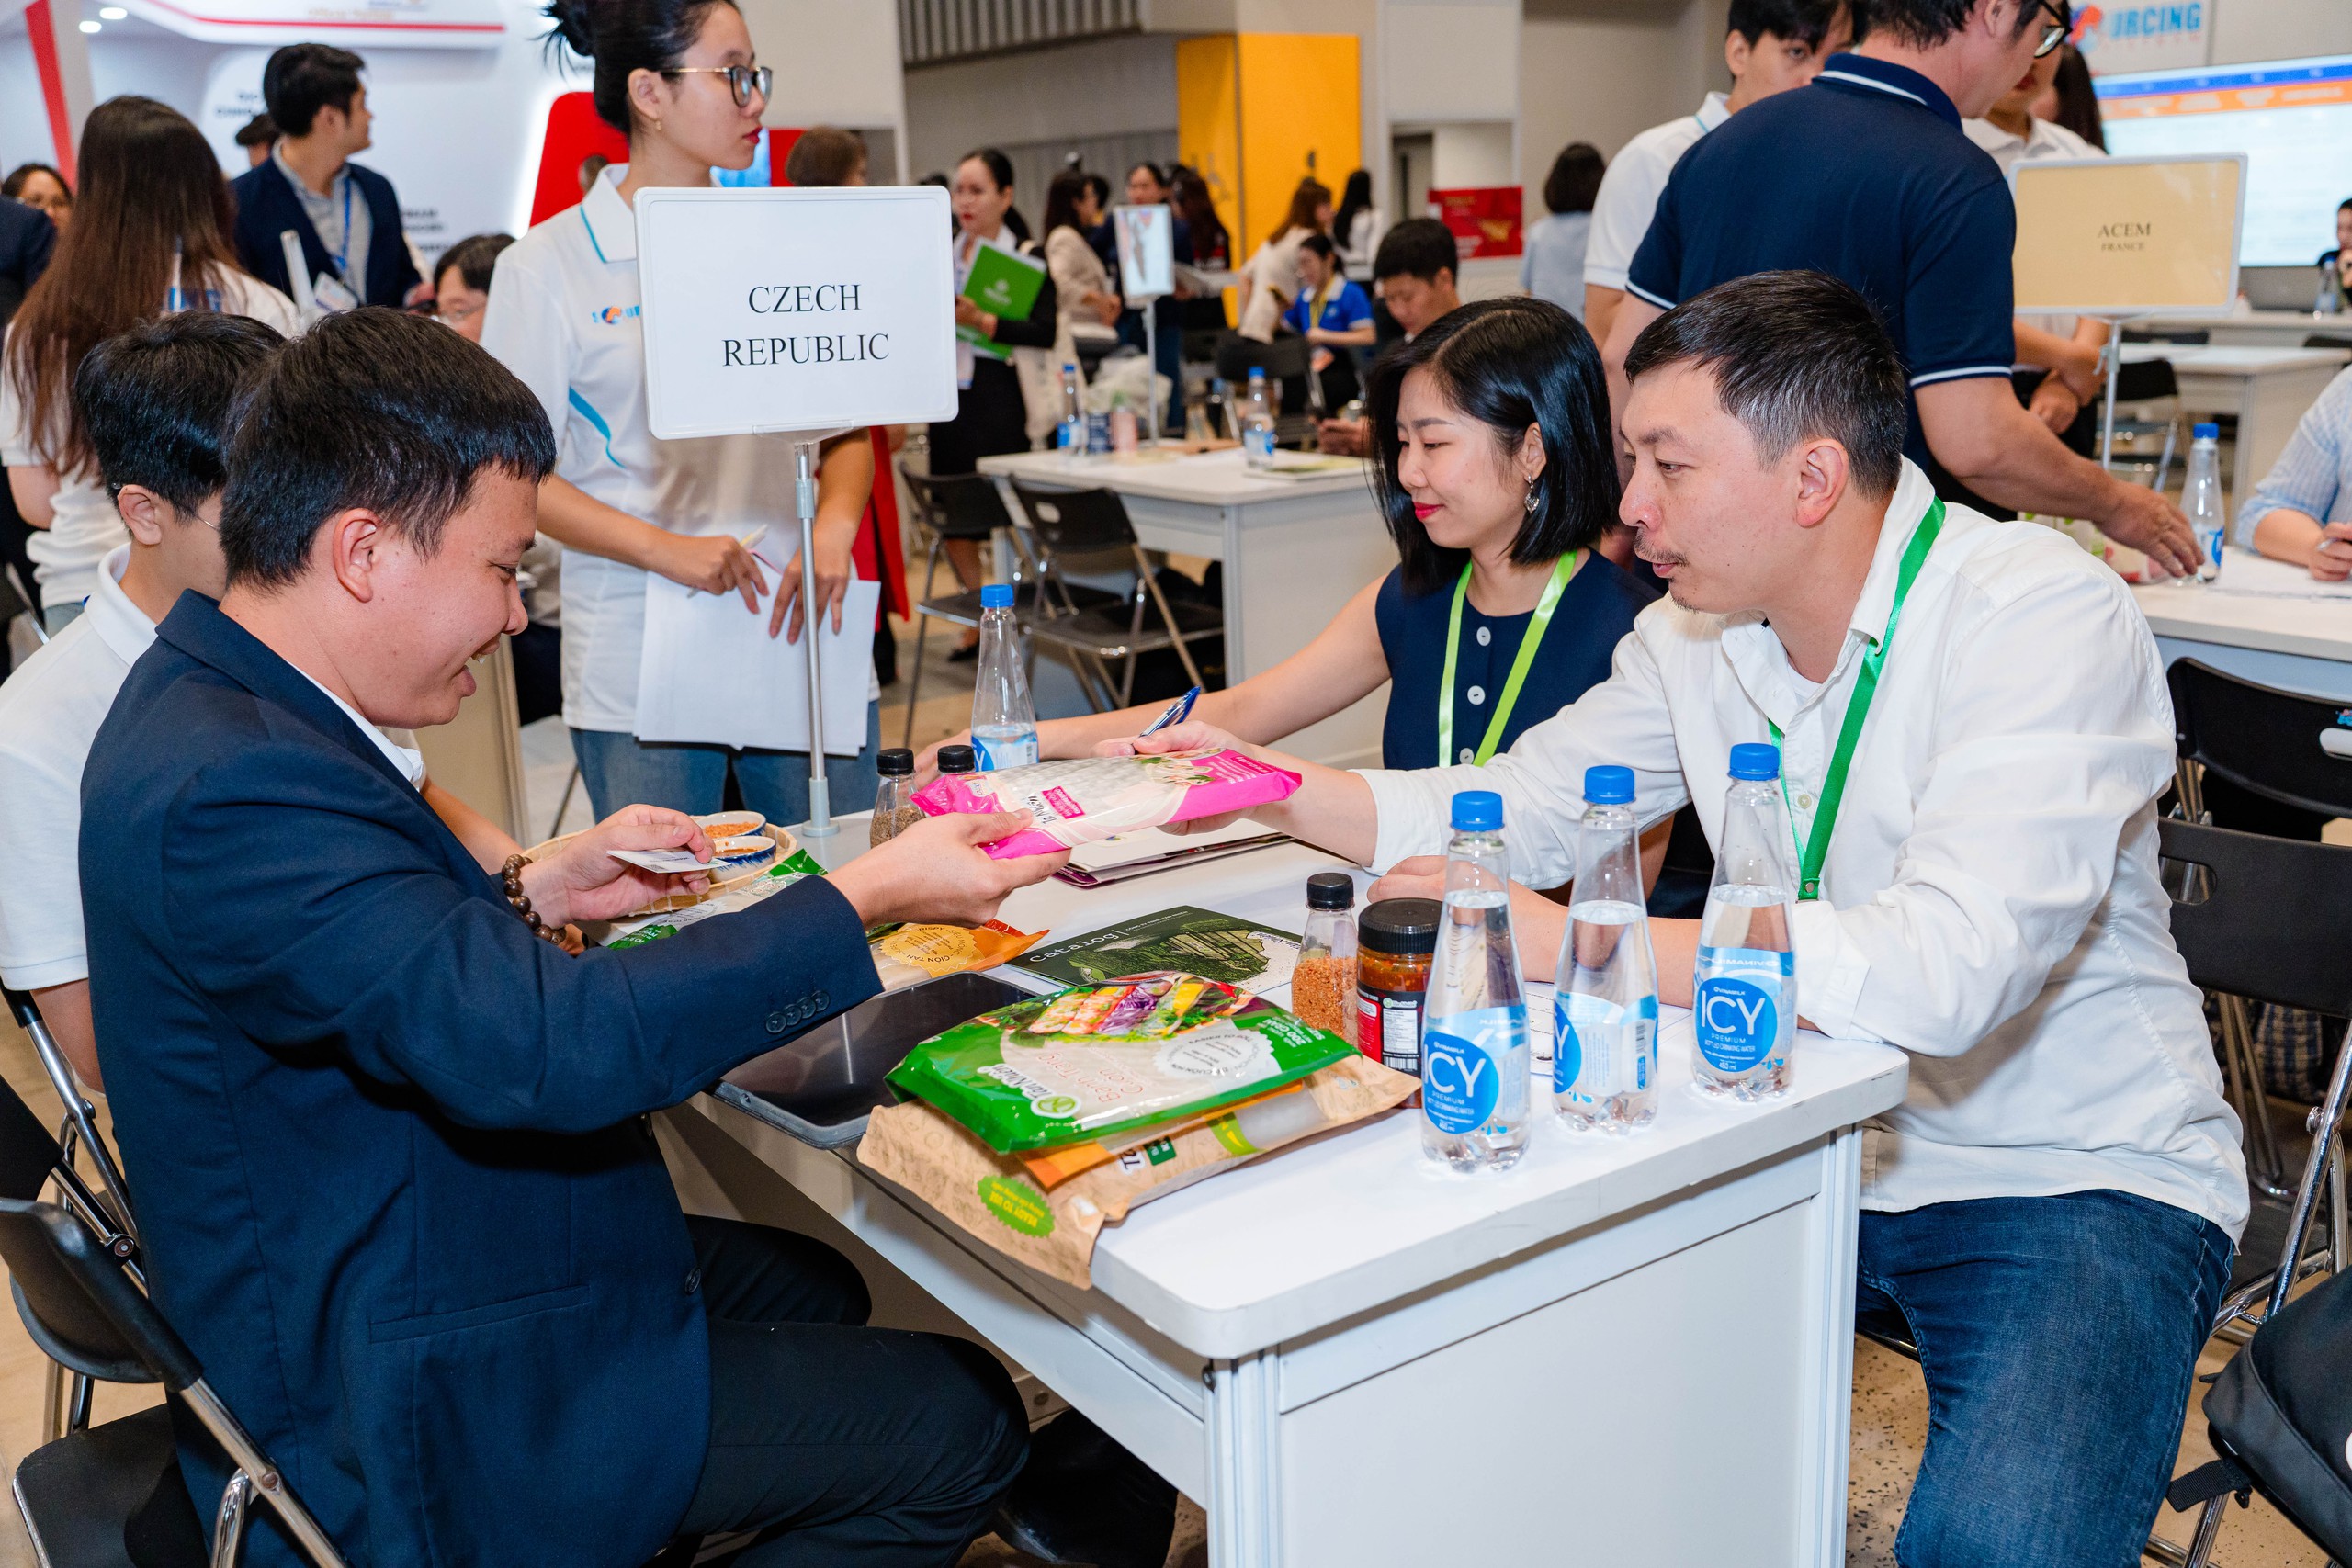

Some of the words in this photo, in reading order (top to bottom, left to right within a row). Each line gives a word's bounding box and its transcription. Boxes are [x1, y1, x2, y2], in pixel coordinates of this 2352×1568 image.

[2097, 221, 2151, 238] ACEM
[2100, 243, 2144, 251] FRANCE
[748, 284, 862, 313] CZECH
[722, 333, 890, 367] REPUBLIC
[1029, 932, 1120, 964] Catalog
[1702, 990, 1766, 1035] ICY
[1262, 1018, 1290, 1032] GRAM
[1286, 1031, 1306, 1046] 200
[1711, 1032, 1747, 1043] PREMIUM
[1424, 1043, 1487, 1098] ICY
[1431, 1089, 1465, 1105] PREMIUM
